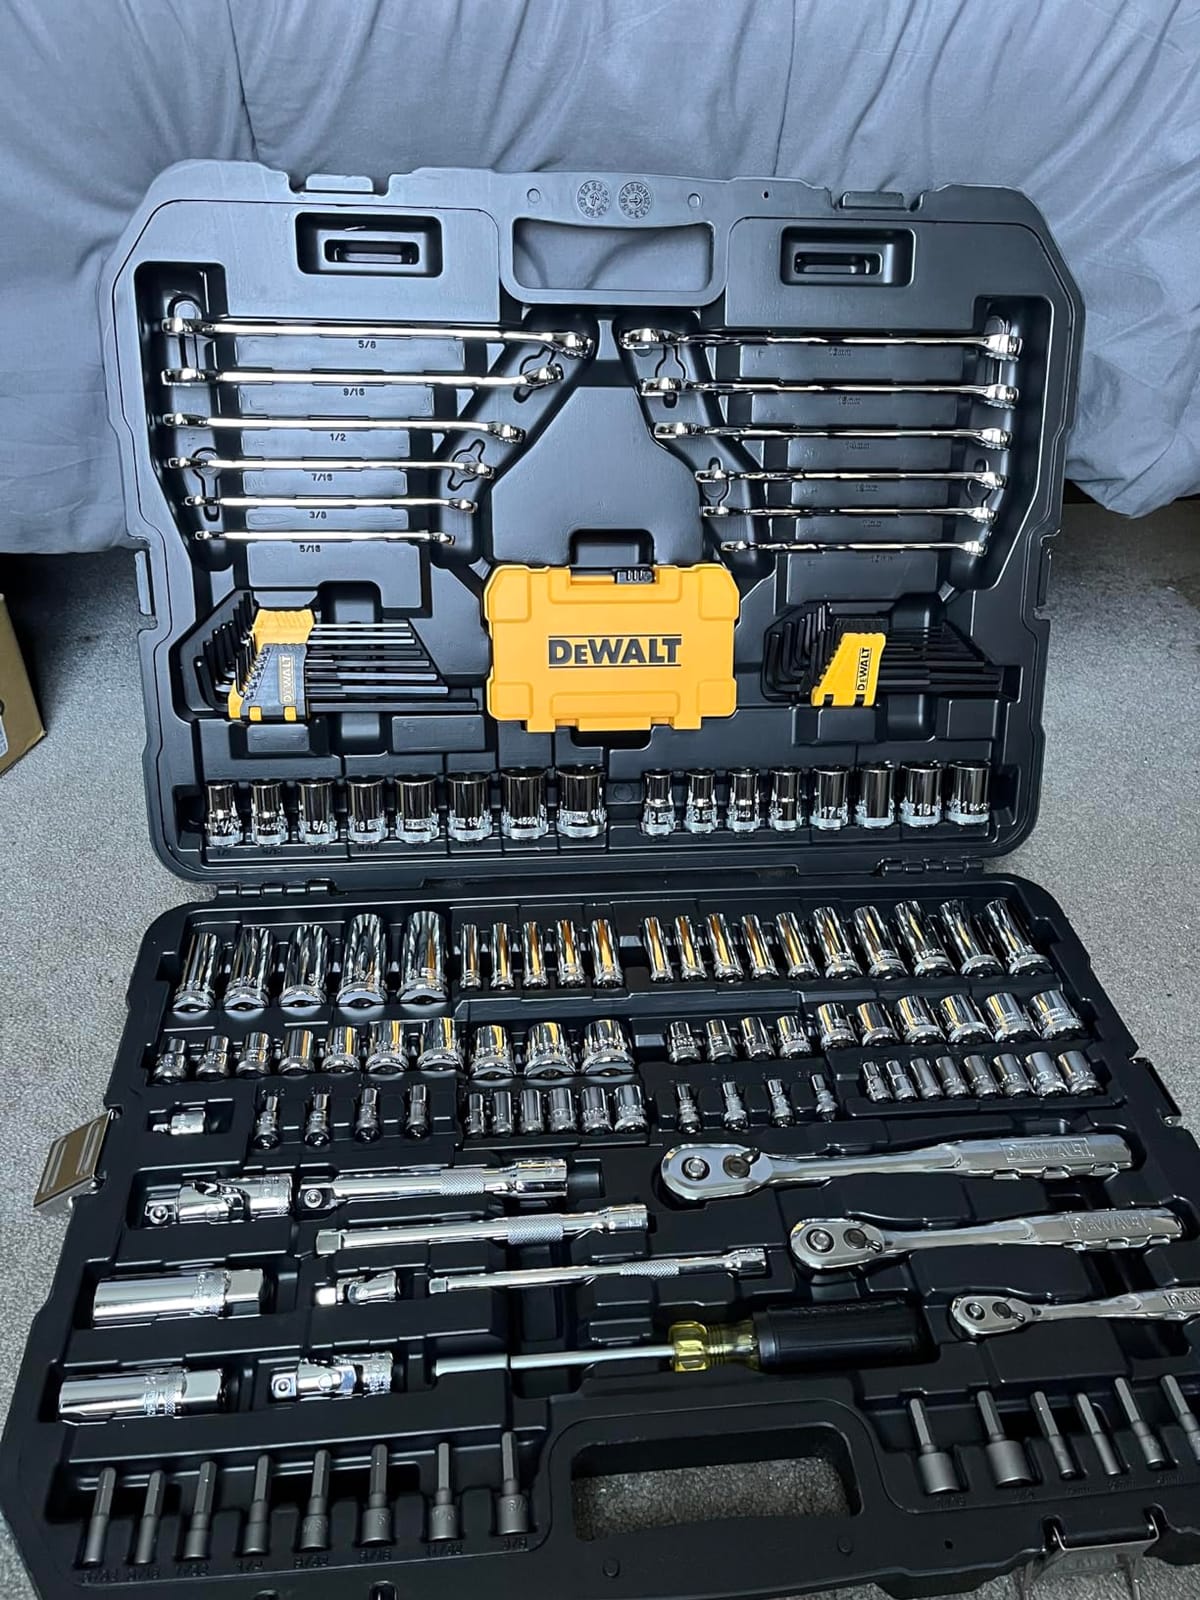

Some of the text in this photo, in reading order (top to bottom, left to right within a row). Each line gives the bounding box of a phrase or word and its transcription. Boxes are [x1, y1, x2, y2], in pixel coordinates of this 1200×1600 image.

[358, 340, 377, 349] 5/8
[343, 387, 365, 396] 9/16
[330, 433, 346, 441] 1/2
[312, 473, 333, 481] 7/16
[309, 511, 327, 519] 3/8
[548, 638, 682, 665] DEWALT
[857, 647, 870, 691] DEWALT
